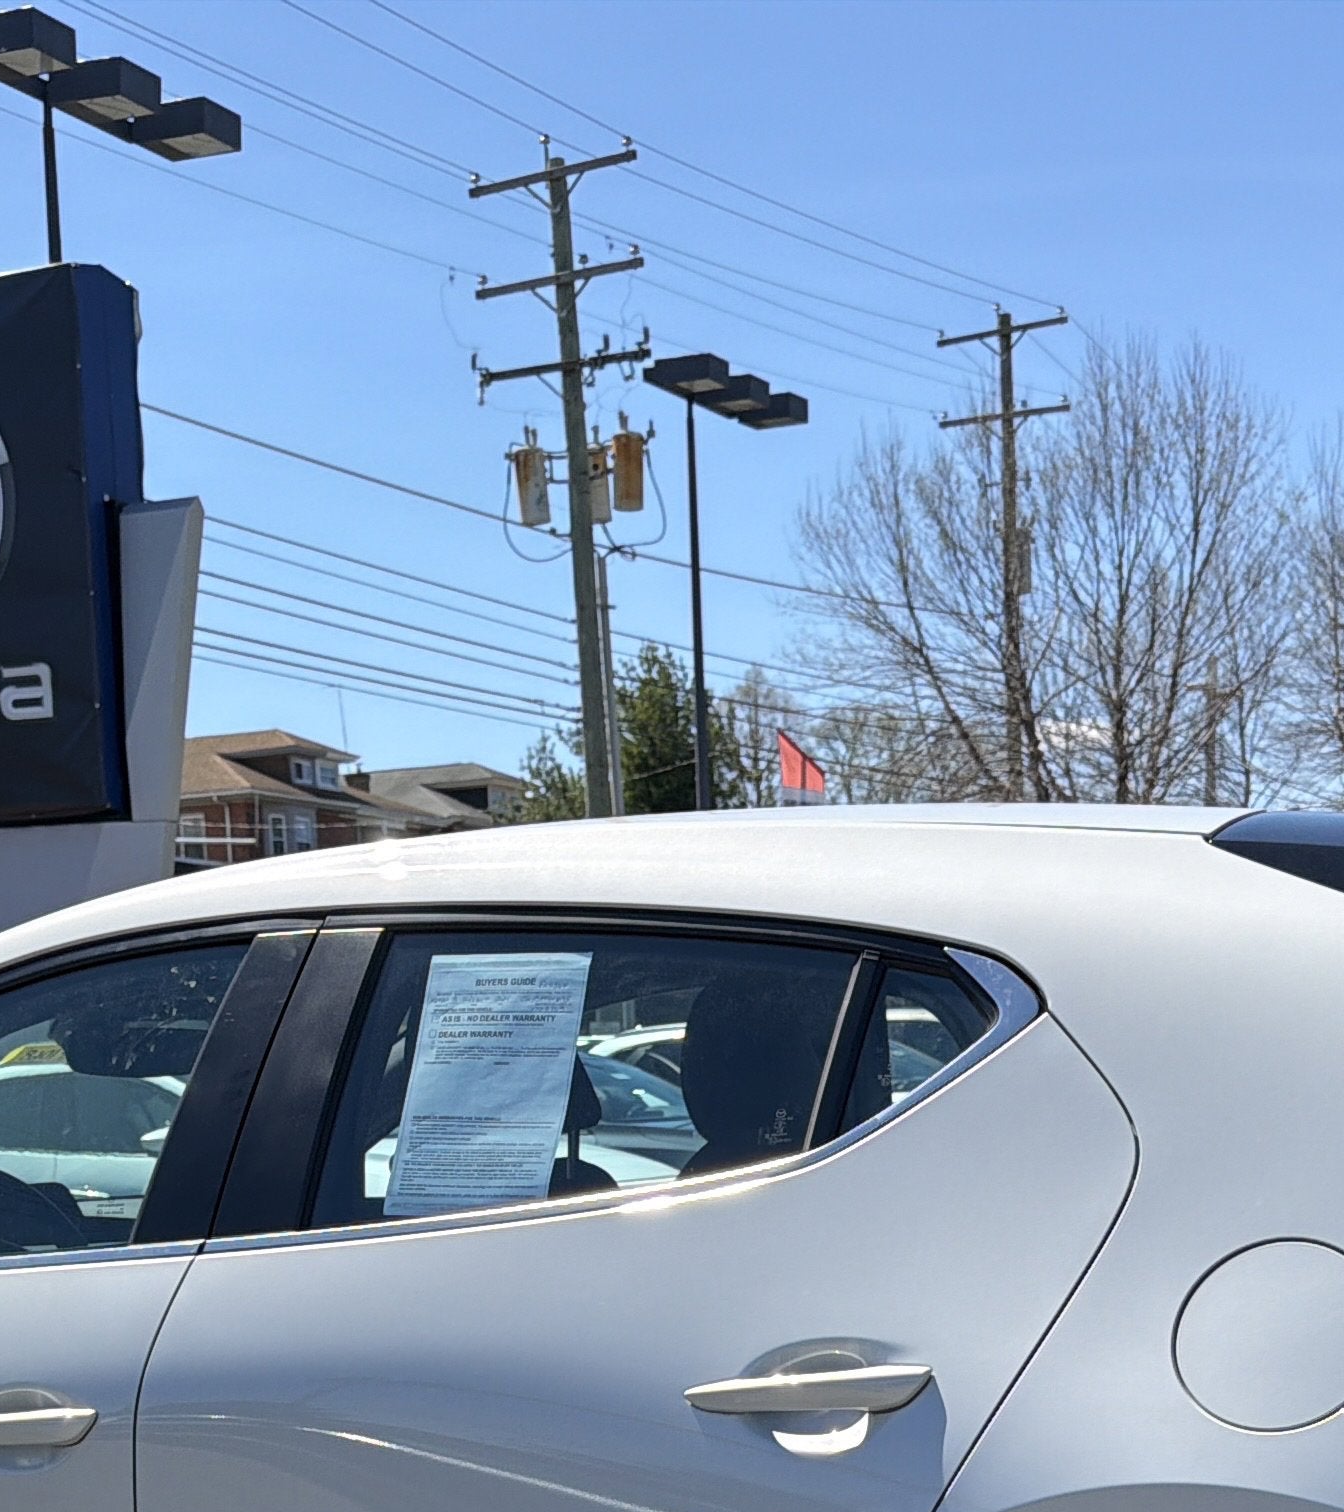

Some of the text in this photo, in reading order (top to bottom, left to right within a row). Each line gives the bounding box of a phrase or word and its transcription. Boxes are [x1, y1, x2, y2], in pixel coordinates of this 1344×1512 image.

[475, 978, 509, 986] BUYERS
[510, 977, 536, 986] GUIDE
[512, 1014, 556, 1023] WARRANTY
[438, 1030, 514, 1039] DEALER WARRANTY
